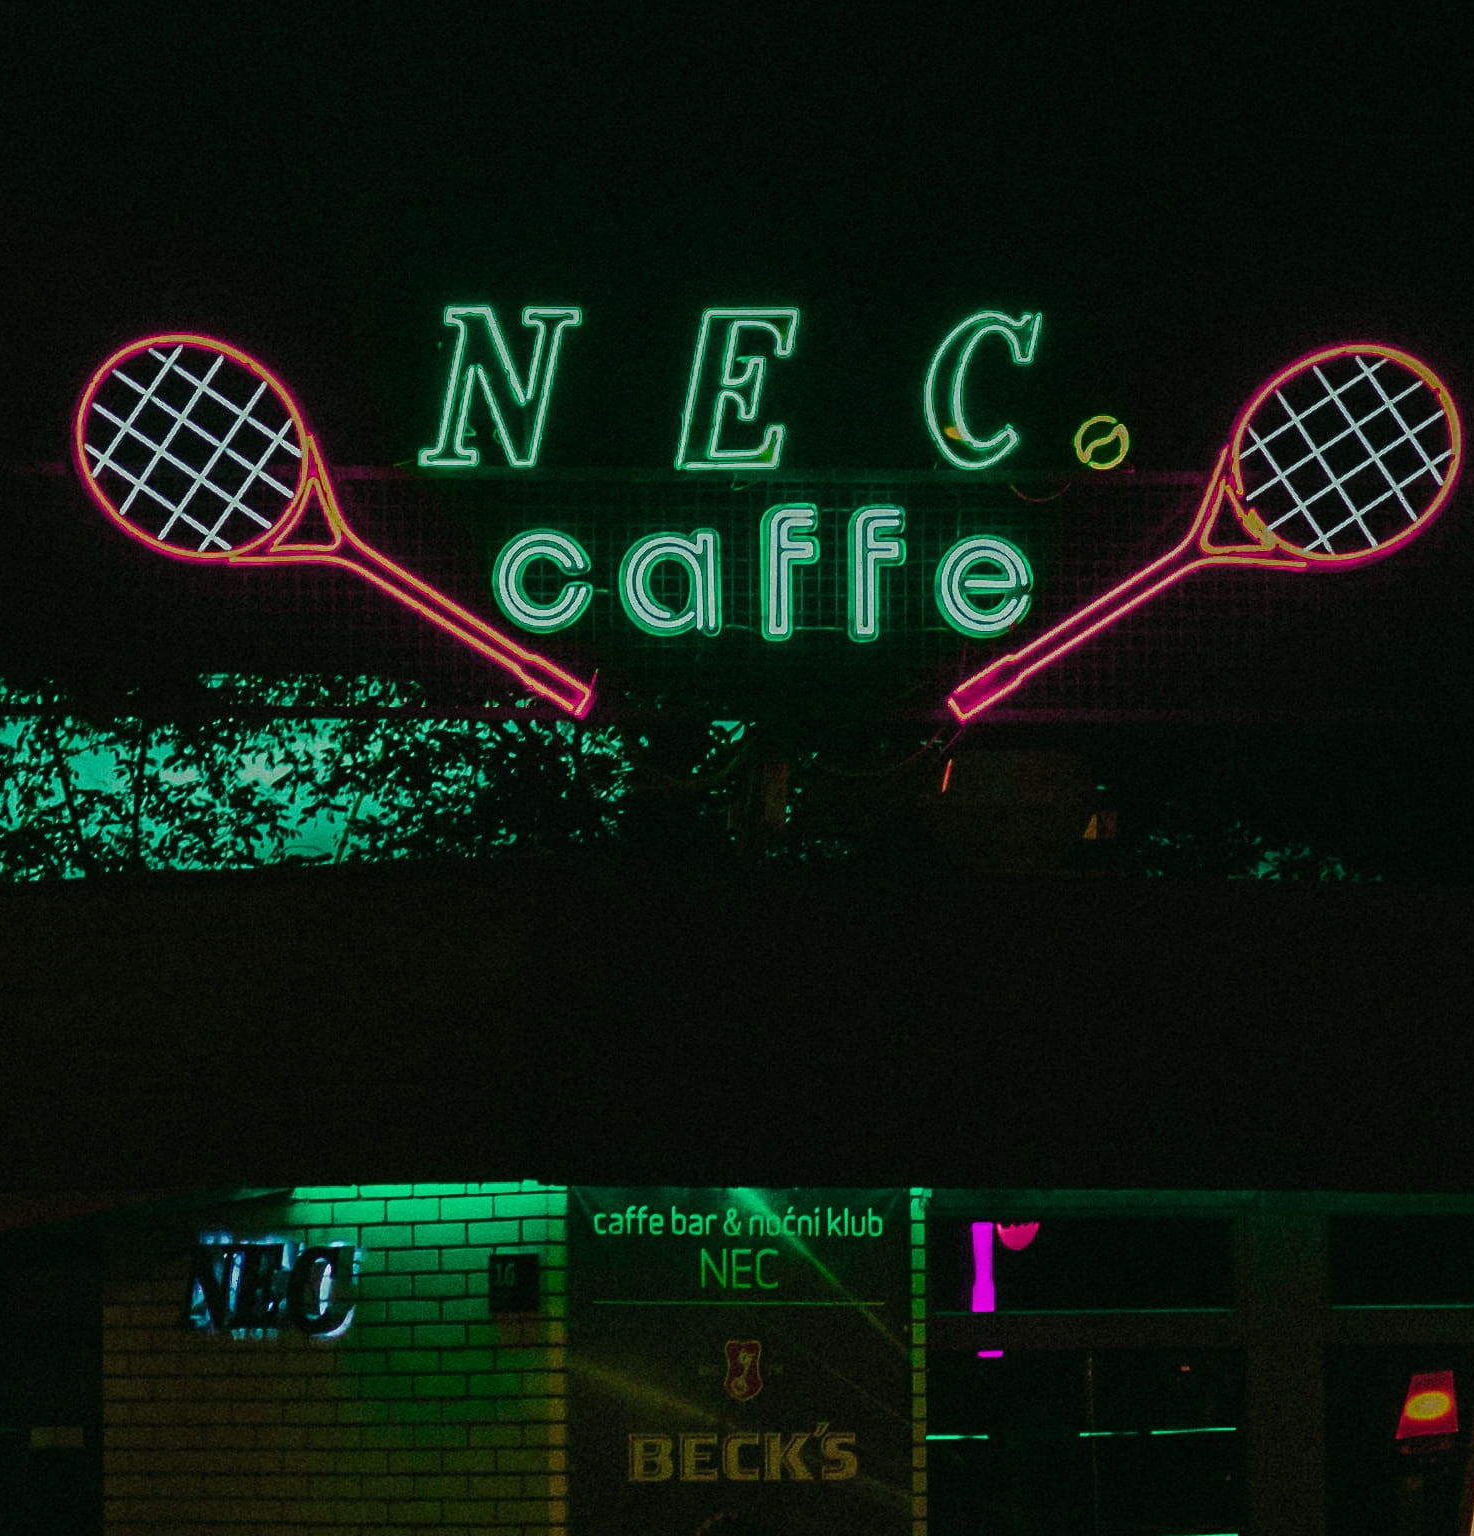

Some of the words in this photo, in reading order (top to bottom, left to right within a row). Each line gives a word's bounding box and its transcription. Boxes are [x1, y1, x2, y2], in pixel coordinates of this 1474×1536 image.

[417, 303, 1044, 471] NEC
[489, 499, 1035, 641] caffe
[592, 1205, 664, 1236] caffe
[670, 1206, 718, 1236] bar
[722, 1207, 742, 1237] &
[826, 1207, 885, 1237] klub
[698, 1248, 780, 1290] NEC
